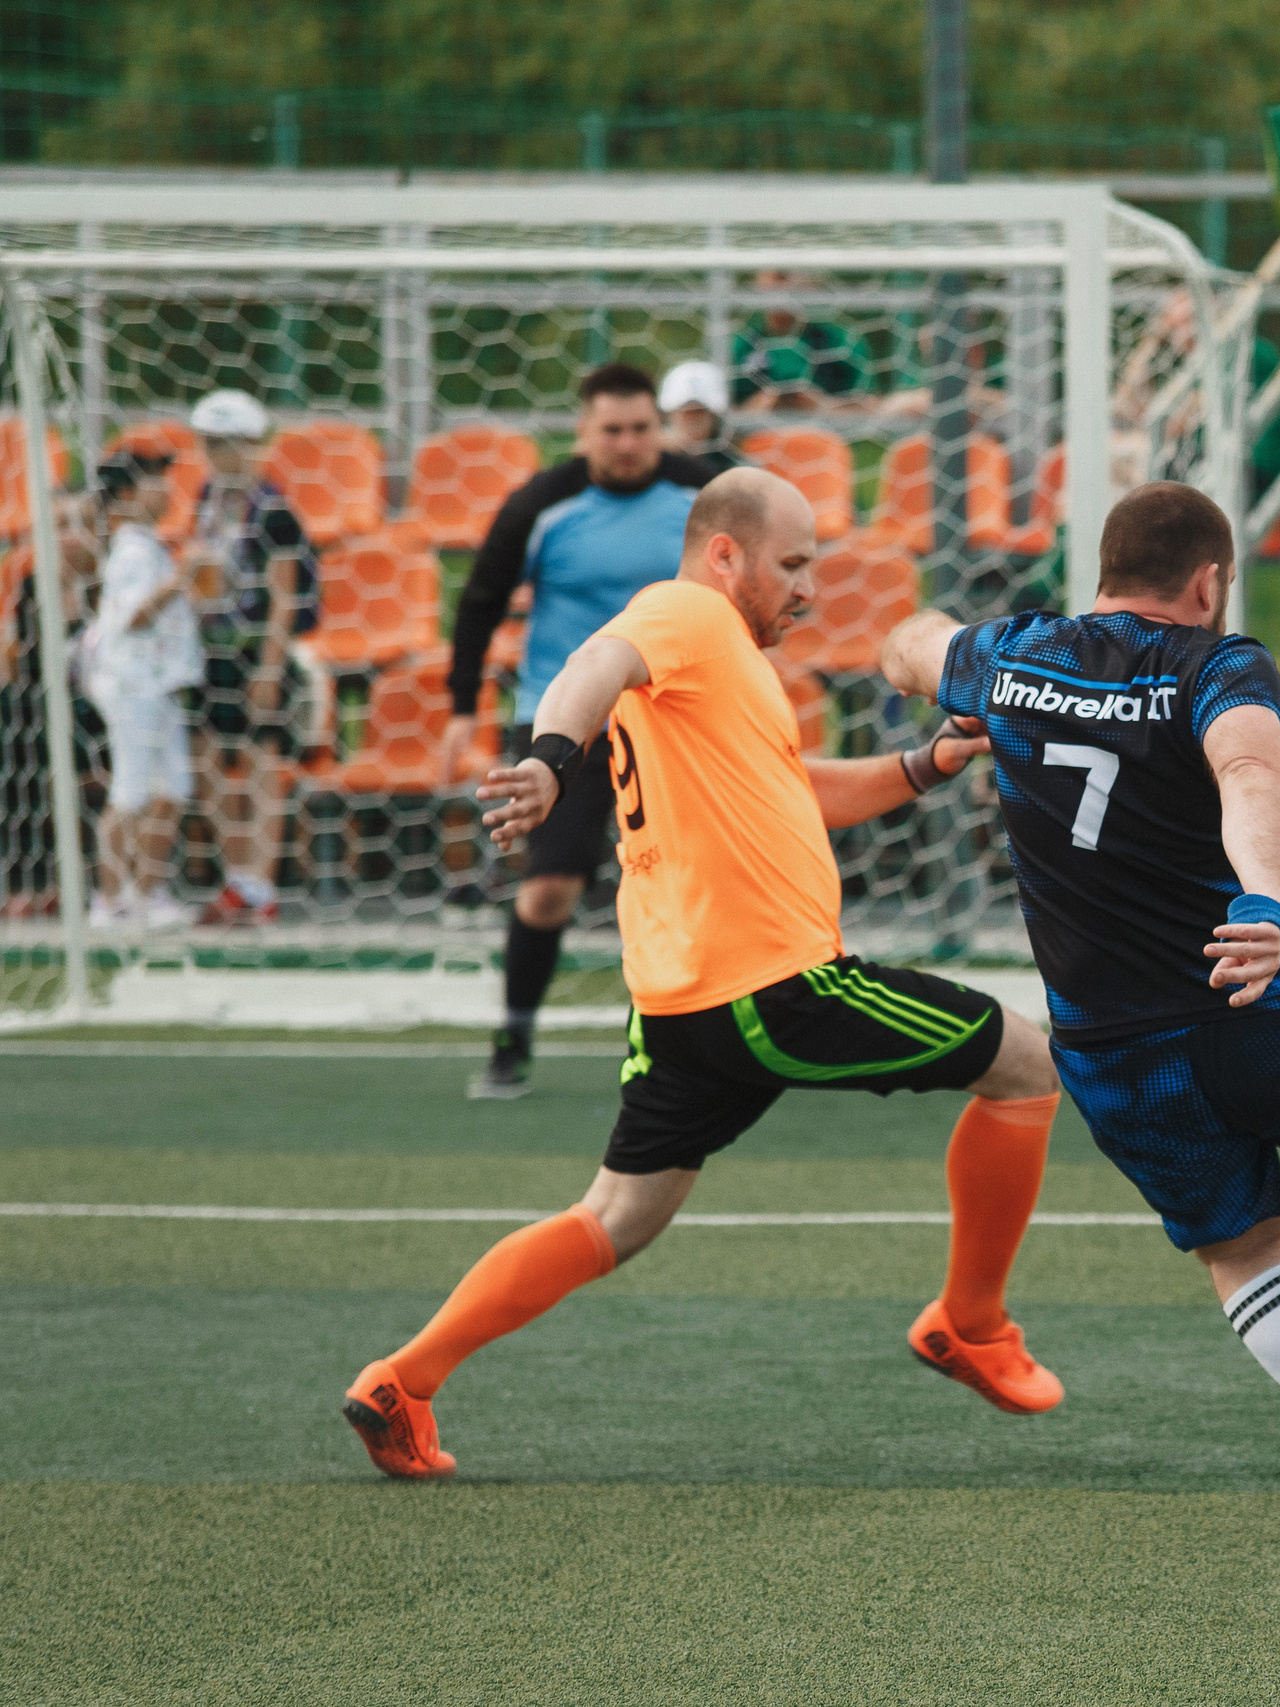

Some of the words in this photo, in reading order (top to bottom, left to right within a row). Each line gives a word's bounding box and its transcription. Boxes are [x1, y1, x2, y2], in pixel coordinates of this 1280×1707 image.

[992, 671, 1142, 722] Umbrella
[1147, 687, 1177, 721] IT
[1042, 742, 1120, 851] 7
